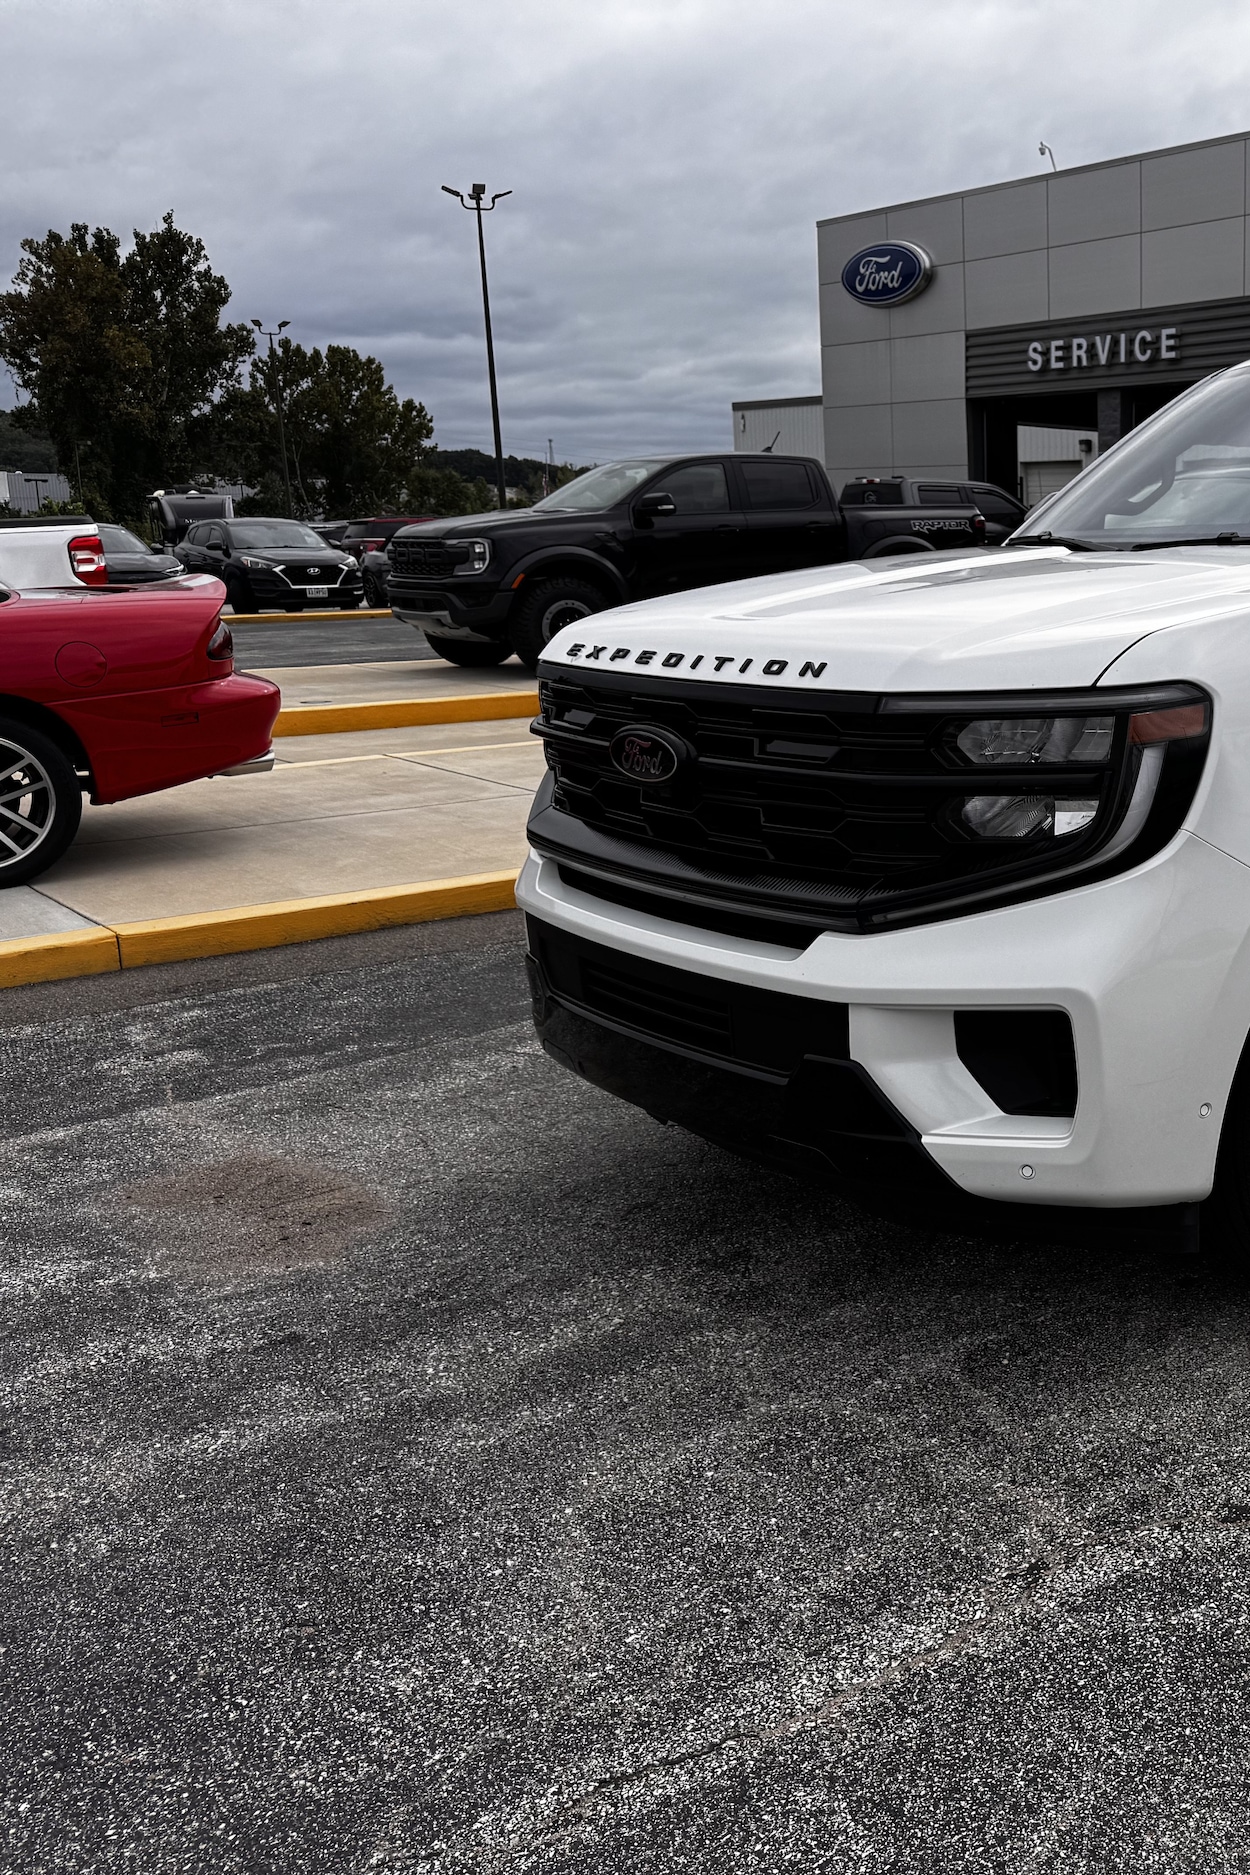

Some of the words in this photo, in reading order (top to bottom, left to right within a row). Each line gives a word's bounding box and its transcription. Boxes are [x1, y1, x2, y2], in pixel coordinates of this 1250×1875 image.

[855, 255, 903, 293] Ford
[1027, 327, 1178, 372] SERVICE
[910, 520, 973, 534] RAPTOR
[566, 643, 828, 678] EXPEDITION
[621, 737, 662, 776] Ford
